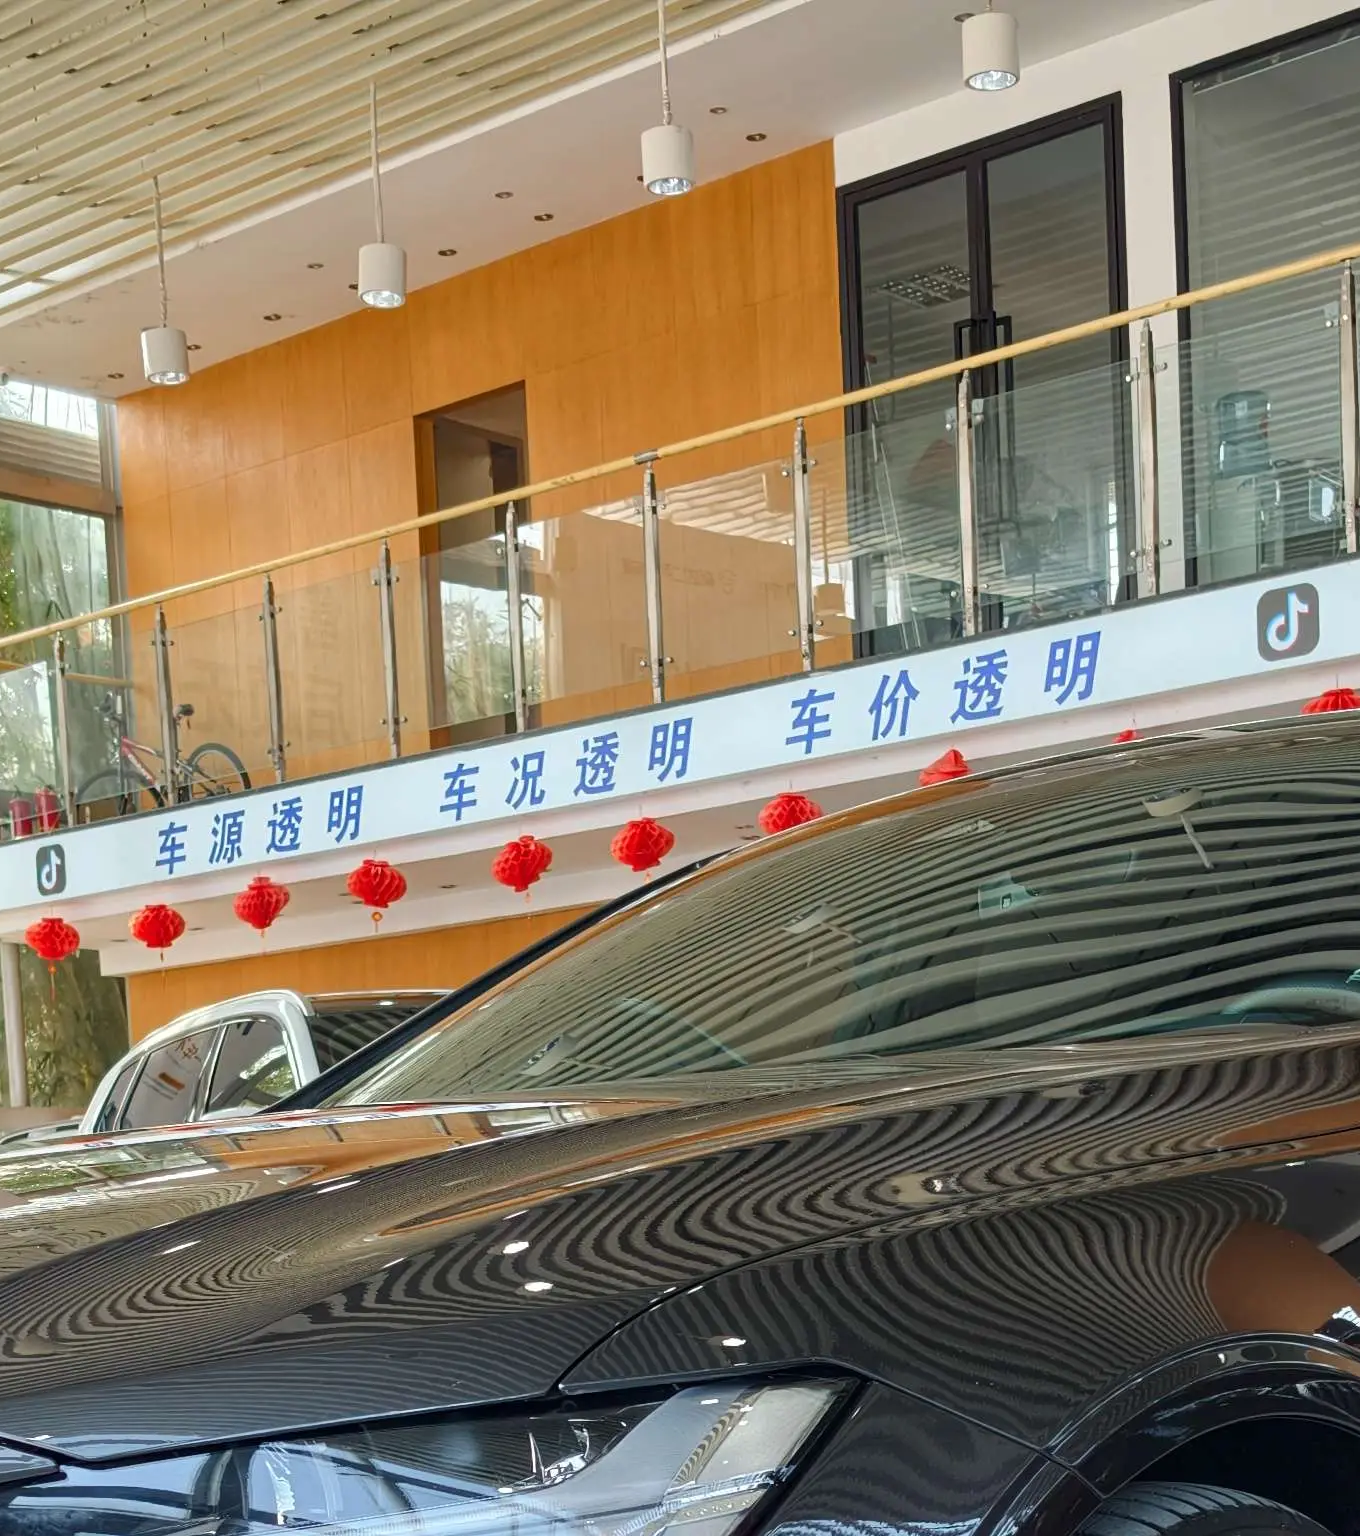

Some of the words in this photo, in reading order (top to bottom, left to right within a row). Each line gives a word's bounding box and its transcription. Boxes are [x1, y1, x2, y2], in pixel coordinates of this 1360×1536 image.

[155, 785, 364, 875] 车源透明
[439, 717, 693, 820] 车况透明
[785, 630, 1102, 755] 车价透明
